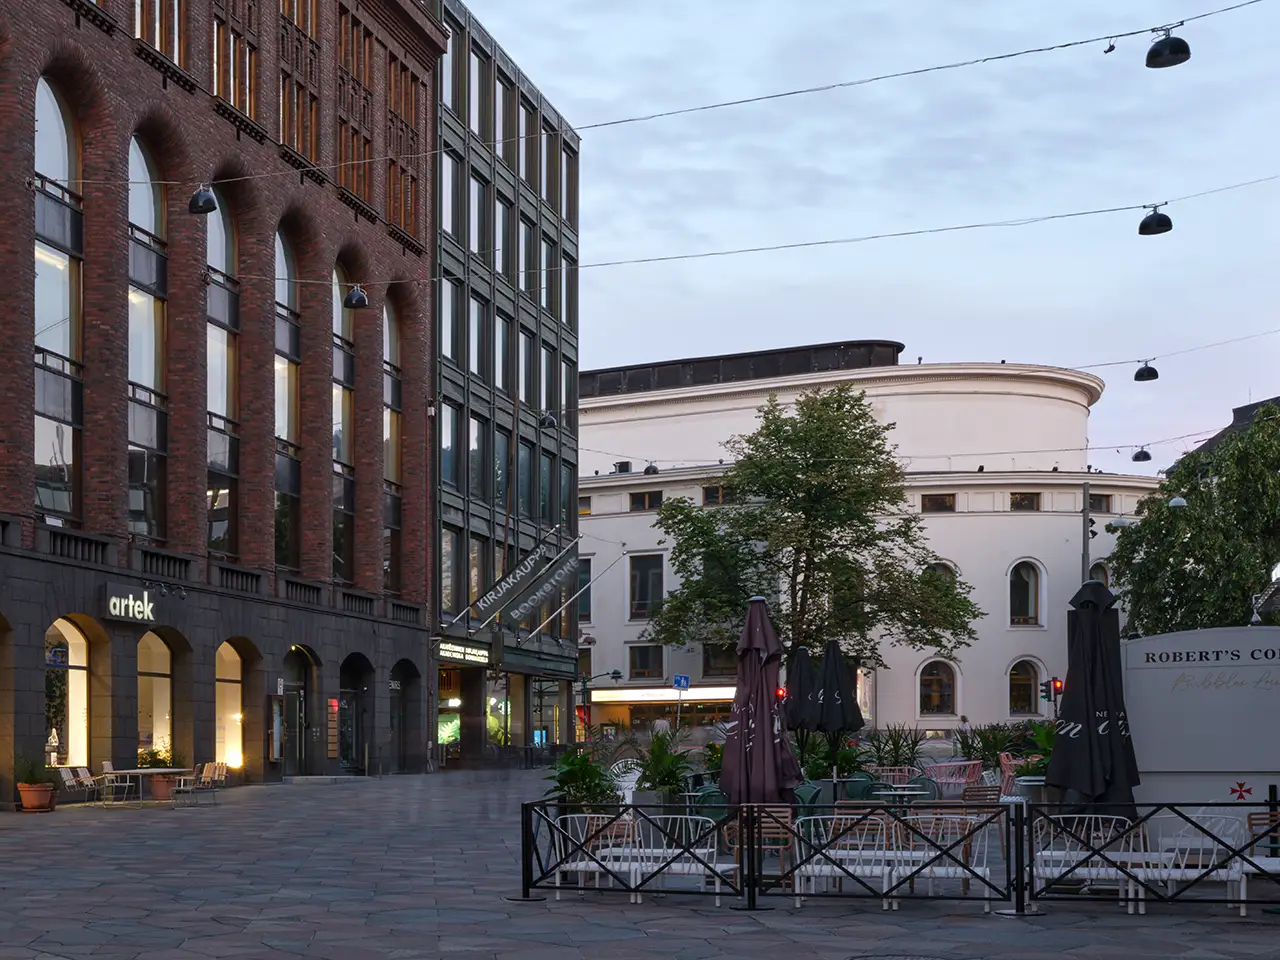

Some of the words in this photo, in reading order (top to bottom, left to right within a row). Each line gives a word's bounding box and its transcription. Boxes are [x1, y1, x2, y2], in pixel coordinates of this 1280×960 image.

[476, 543, 547, 611] KIRJAKAUPPA
[510, 556, 579, 621] BOOKSTORE
[109, 591, 155, 621] artek
[1144, 649, 1241, 663] ROBERT'S
